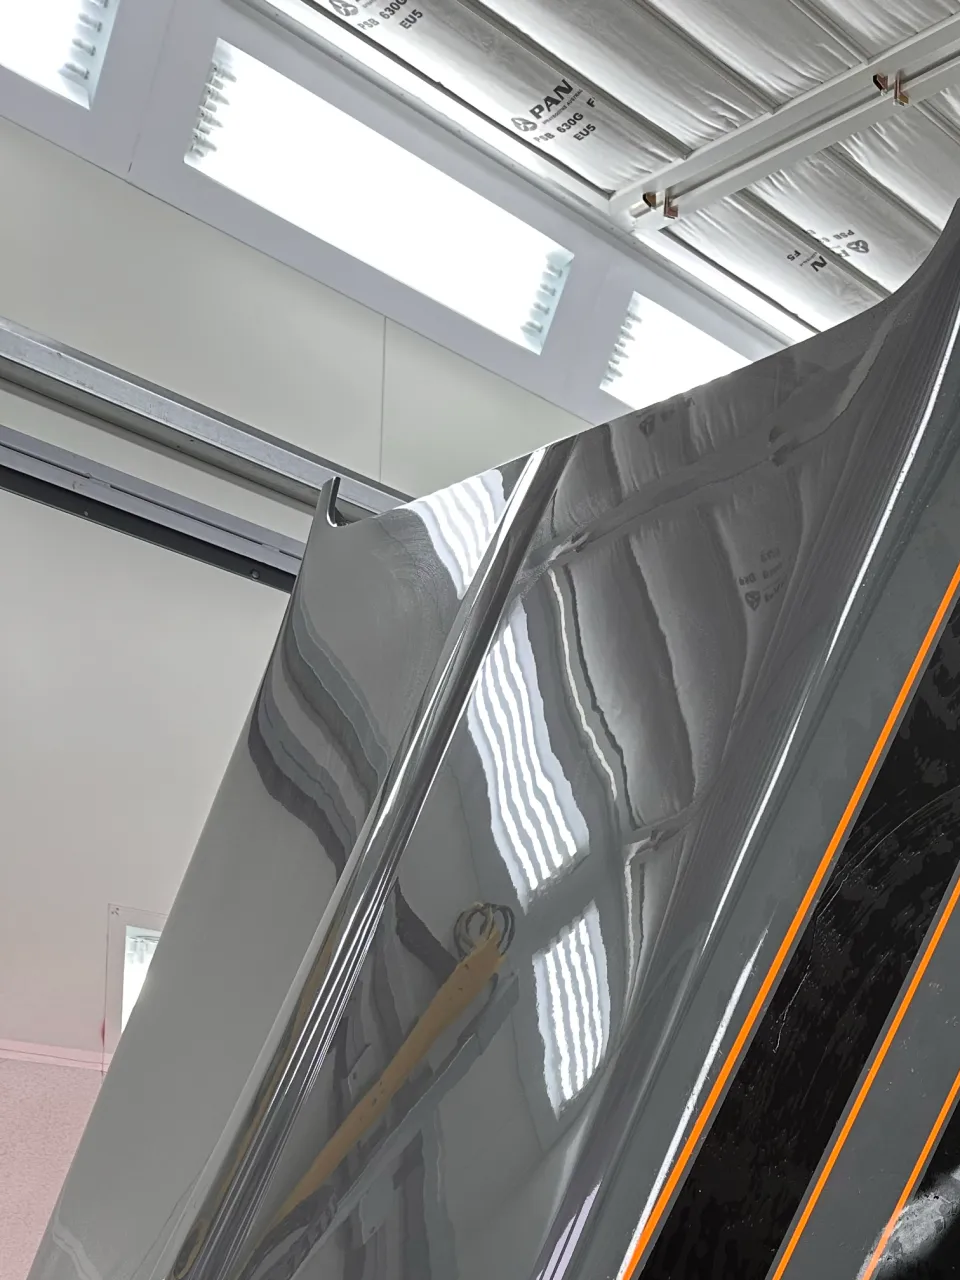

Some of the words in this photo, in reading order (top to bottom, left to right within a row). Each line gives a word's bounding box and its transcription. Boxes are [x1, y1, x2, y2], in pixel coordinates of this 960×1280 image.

[357, 18, 380, 30] PSB
[399, 9, 423, 29] EU5
[529, 79, 573, 119] PAN
[533, 132, 555, 142] PSB
[557, 112, 584, 133] 630G
[573, 123, 596, 141] EU5
[833, 229, 855, 240] PSB
[787, 250, 801, 261] F5
